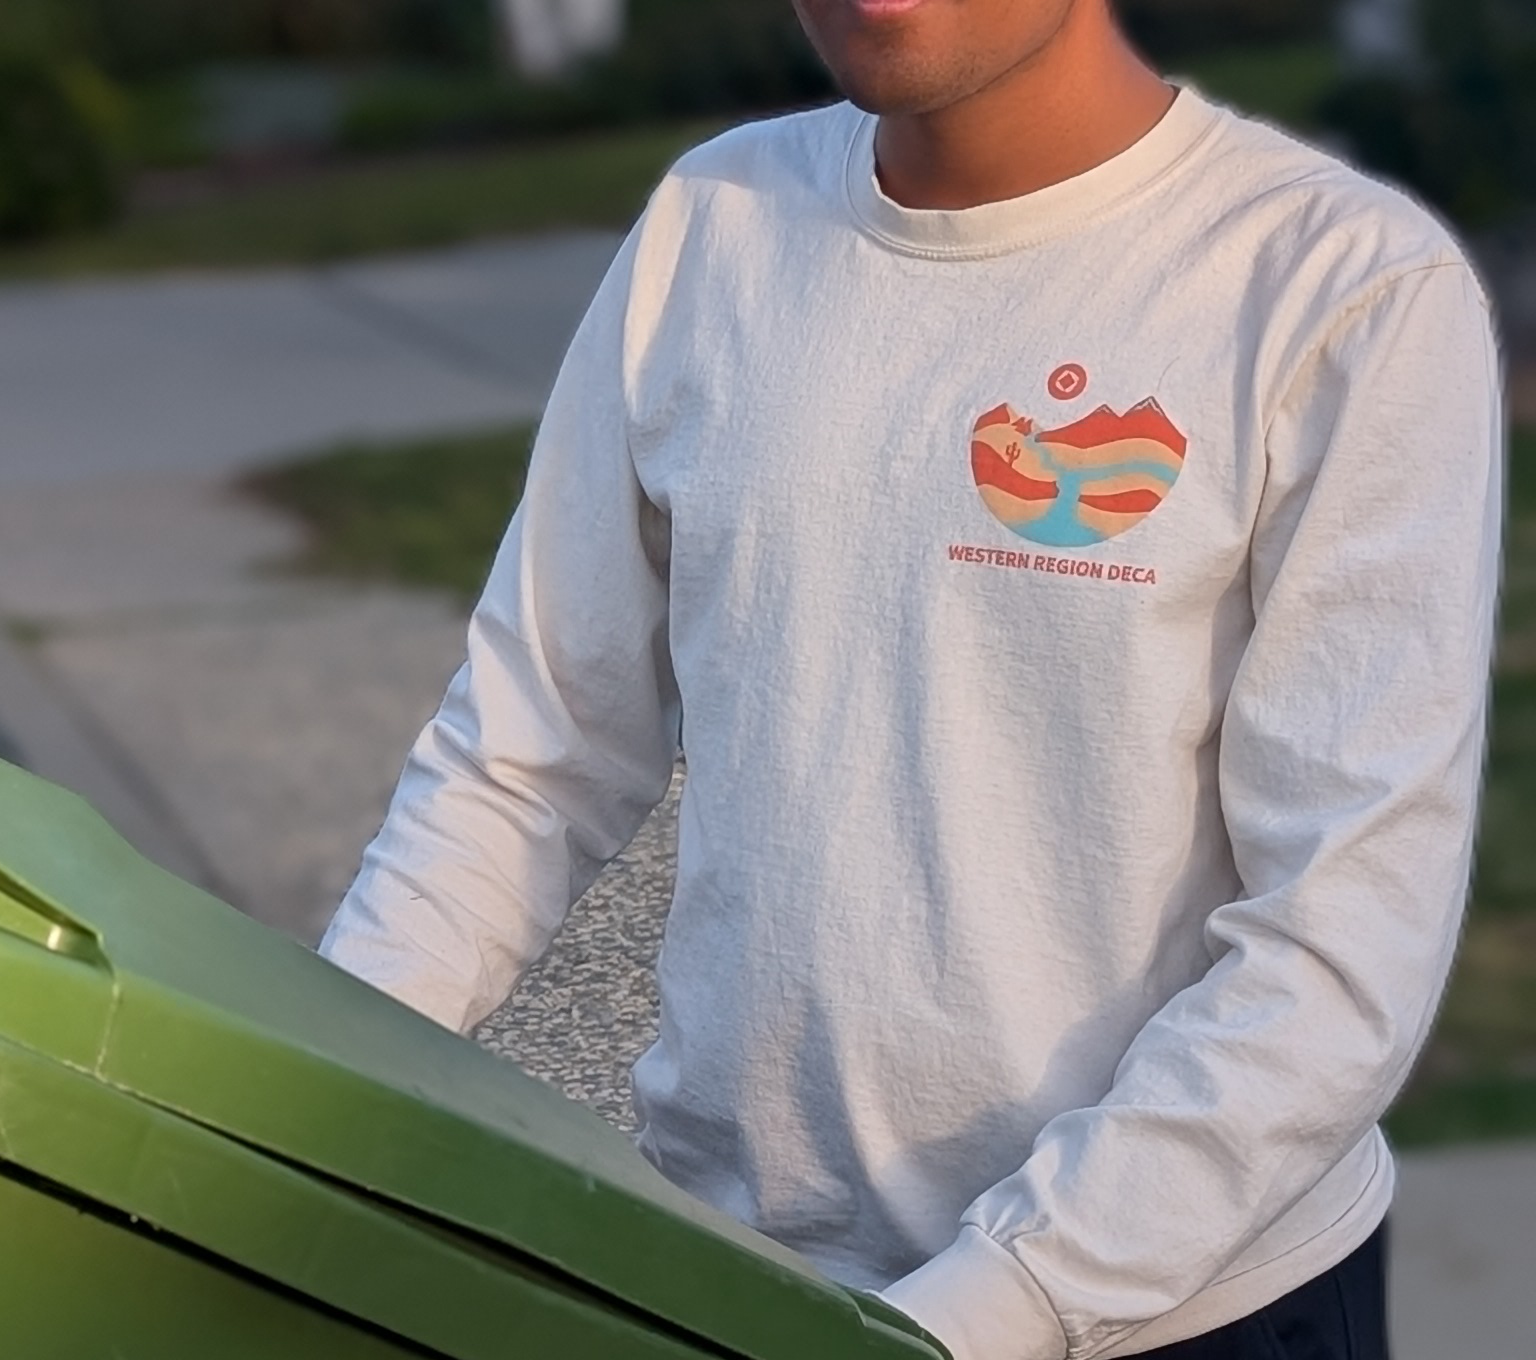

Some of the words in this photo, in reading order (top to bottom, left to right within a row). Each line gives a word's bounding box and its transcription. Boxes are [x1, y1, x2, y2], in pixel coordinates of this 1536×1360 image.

[948, 544, 1030, 569] WESTERN
[1032, 555, 1104, 579] REGION
[1107, 564, 1157, 584] DECA
